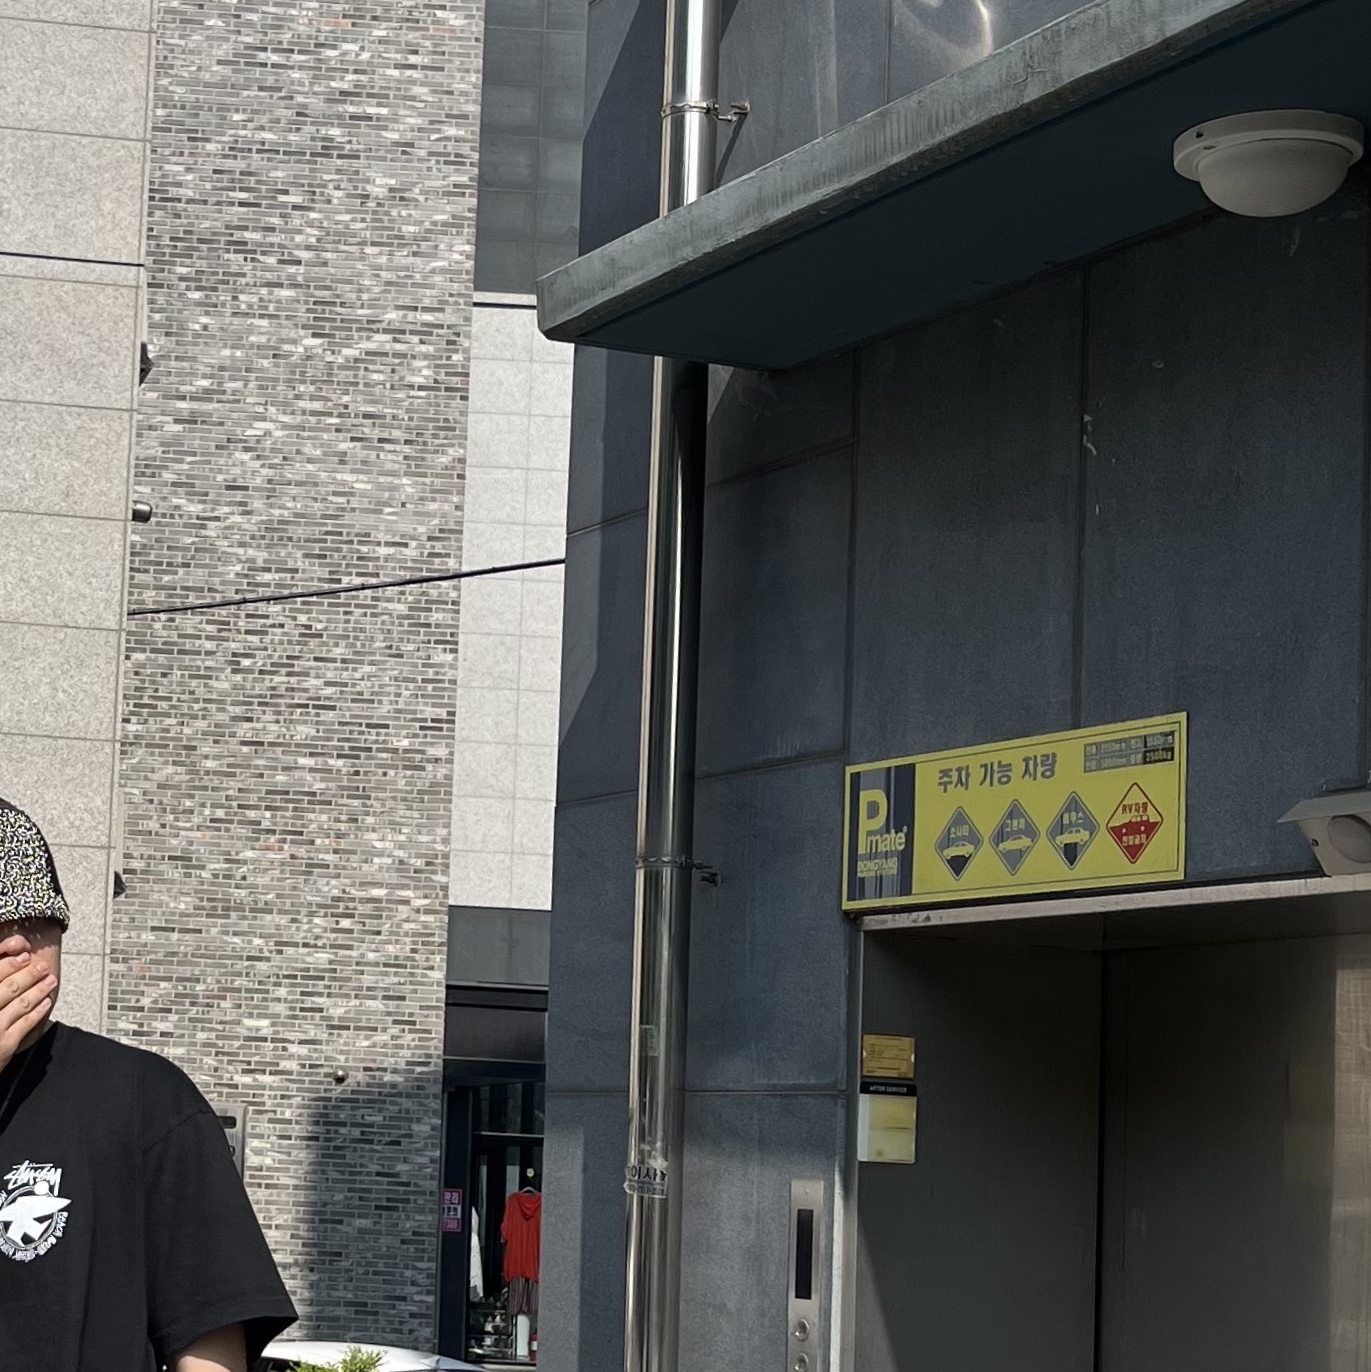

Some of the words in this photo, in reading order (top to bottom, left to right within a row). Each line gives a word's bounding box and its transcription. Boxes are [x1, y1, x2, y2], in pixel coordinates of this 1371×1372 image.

[938, 764, 971, 793] 주차
[980, 760, 1012, 788] 가능
[1022, 752, 1058, 781] 차량
